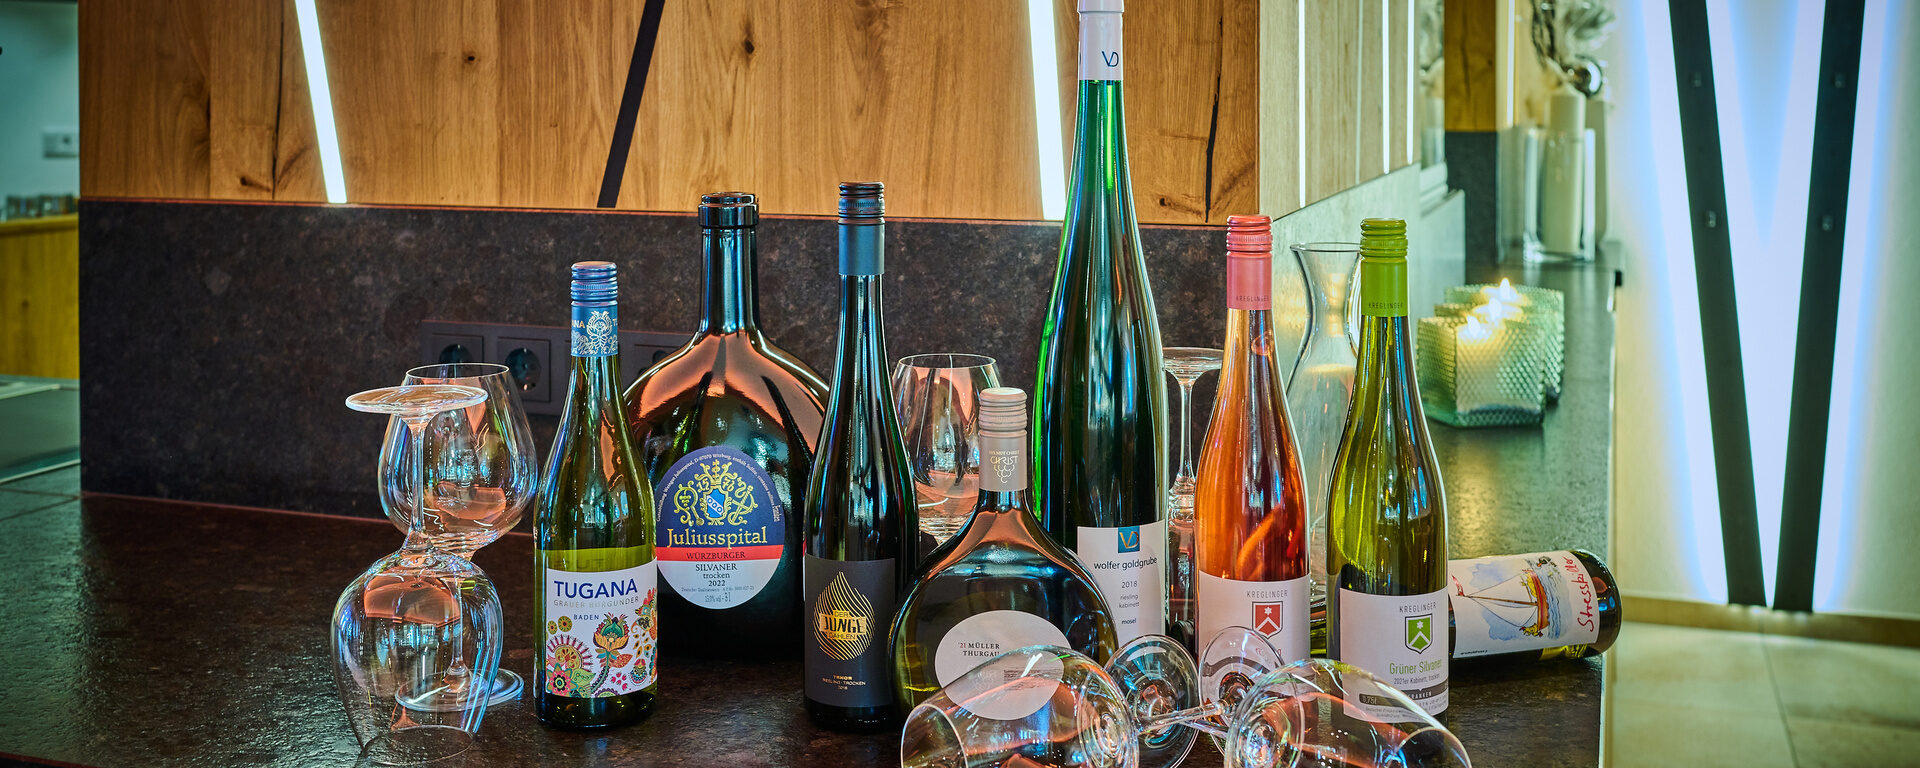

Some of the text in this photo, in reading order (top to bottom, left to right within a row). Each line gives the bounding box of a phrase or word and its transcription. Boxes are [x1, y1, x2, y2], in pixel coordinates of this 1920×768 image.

[666, 525, 768, 549] Juliusspital
[686, 551, 746, 560] WÜRZBURGER
[695, 563, 738, 572] SILVANER
[1093, 556, 1158, 571] wolfer goldgrube
[703, 571, 731, 579] trocken
[553, 578, 638, 599] TUGANA
[1121, 580, 1138, 588] 2018
[1246, 589, 1288, 599] KREGLINGER
[554, 596, 639, 608] GRAUER BURGUNDER
[1399, 601, 1437, 613] KREGLINGER
[823, 616, 864, 633] JUNGE
[1121, 617, 1137, 625] mosel
[828, 632, 856, 640] DAHLEN
[968, 641, 1000, 650] MÜLLER
[1389, 658, 1442, 675] Grüner Silvaner
